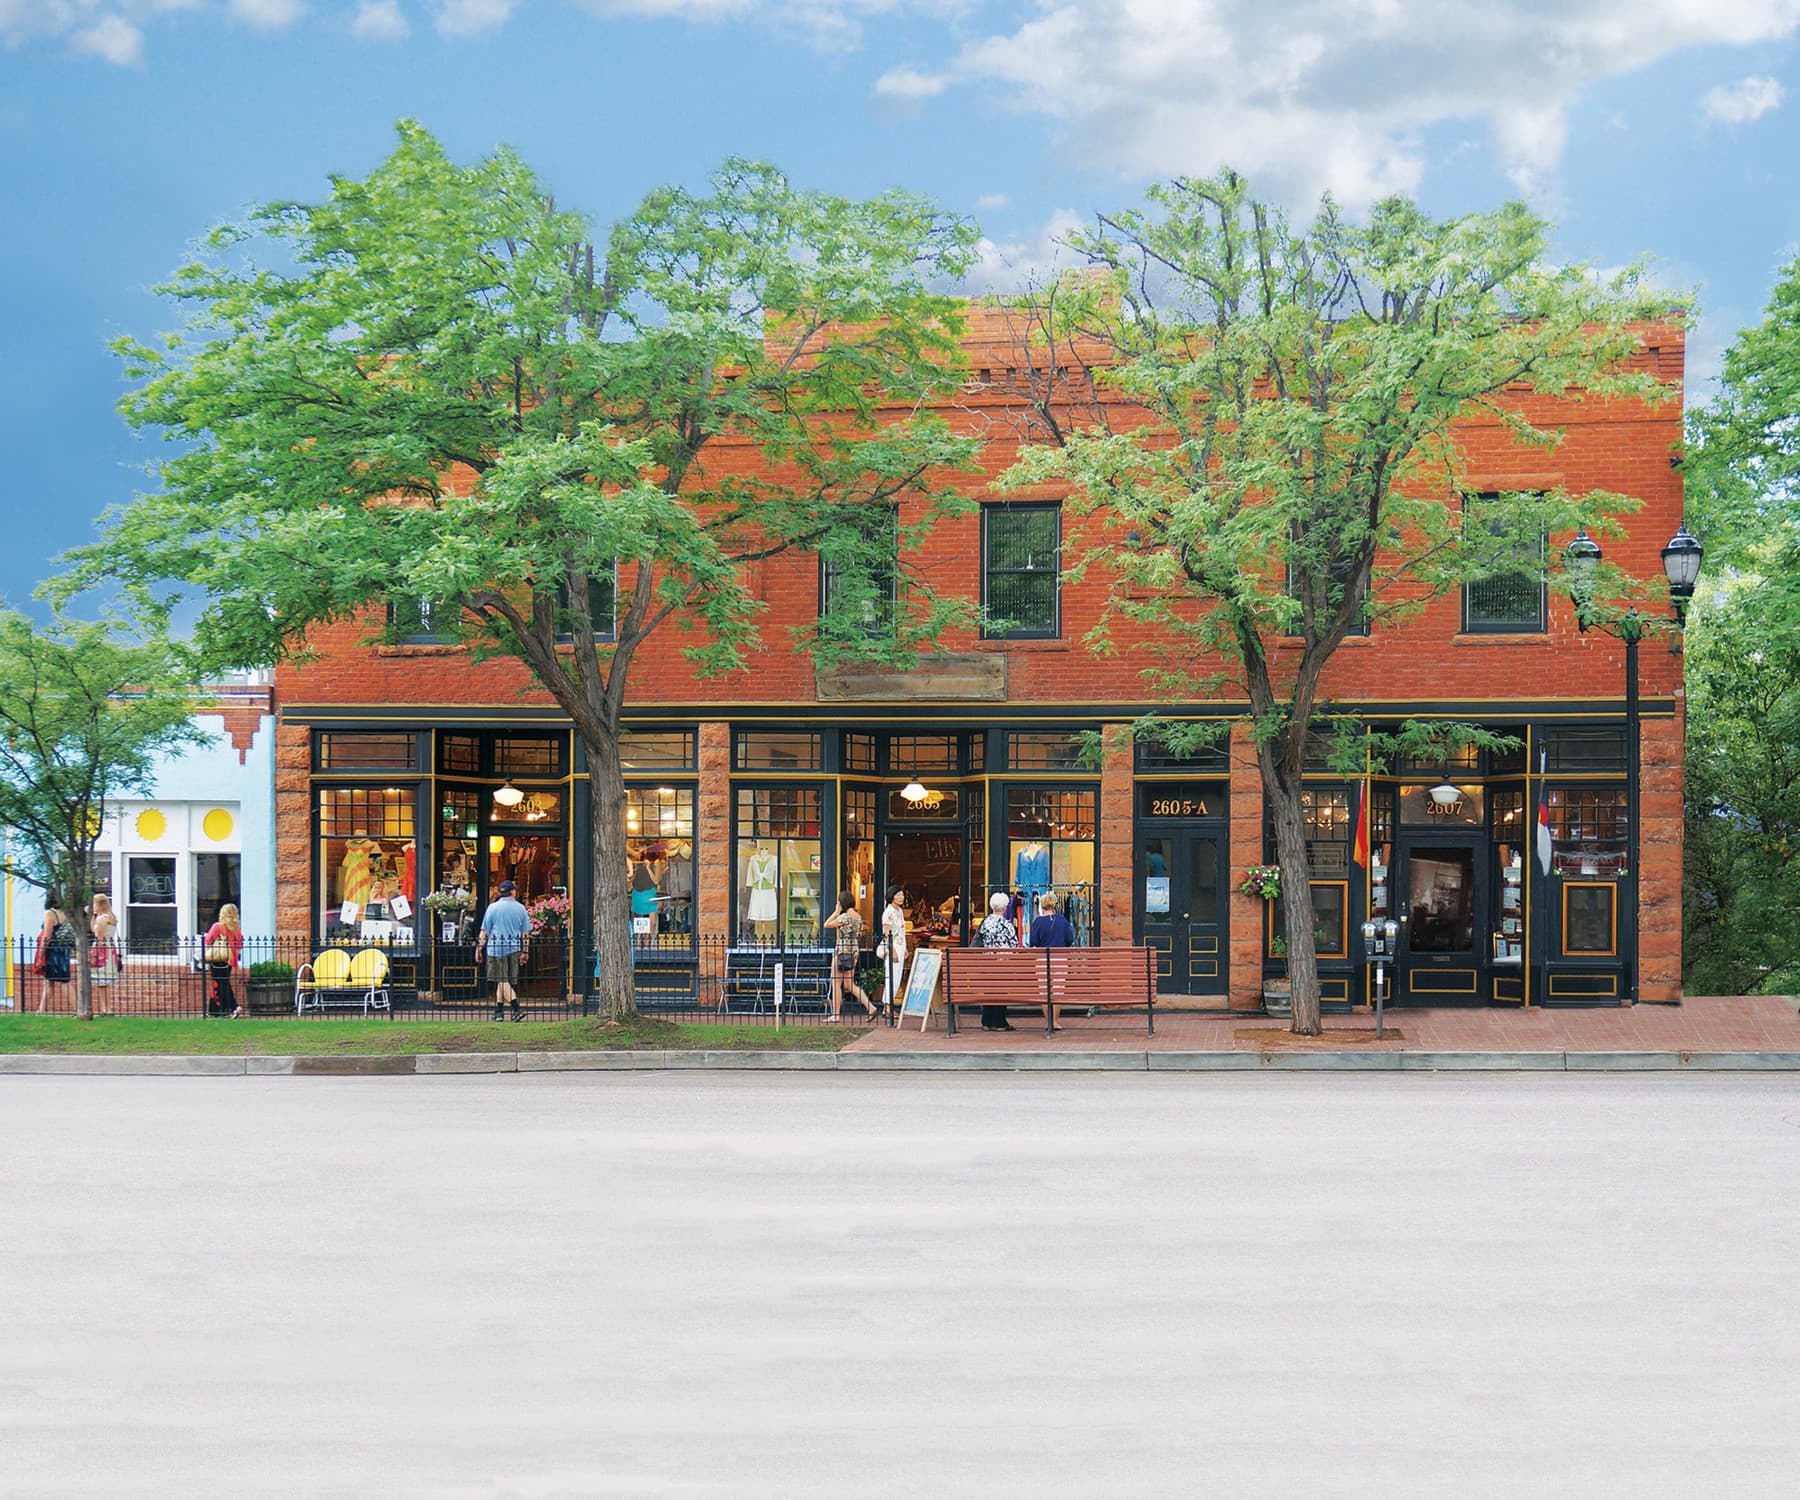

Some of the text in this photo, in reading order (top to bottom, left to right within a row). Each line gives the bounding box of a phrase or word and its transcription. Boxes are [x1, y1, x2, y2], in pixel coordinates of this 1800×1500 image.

[907, 797, 940, 810] 2605
[1152, 799, 1209, 815] 2605-A
[1426, 800, 1464, 815] 2607
[132, 875, 176, 892] OPEN
